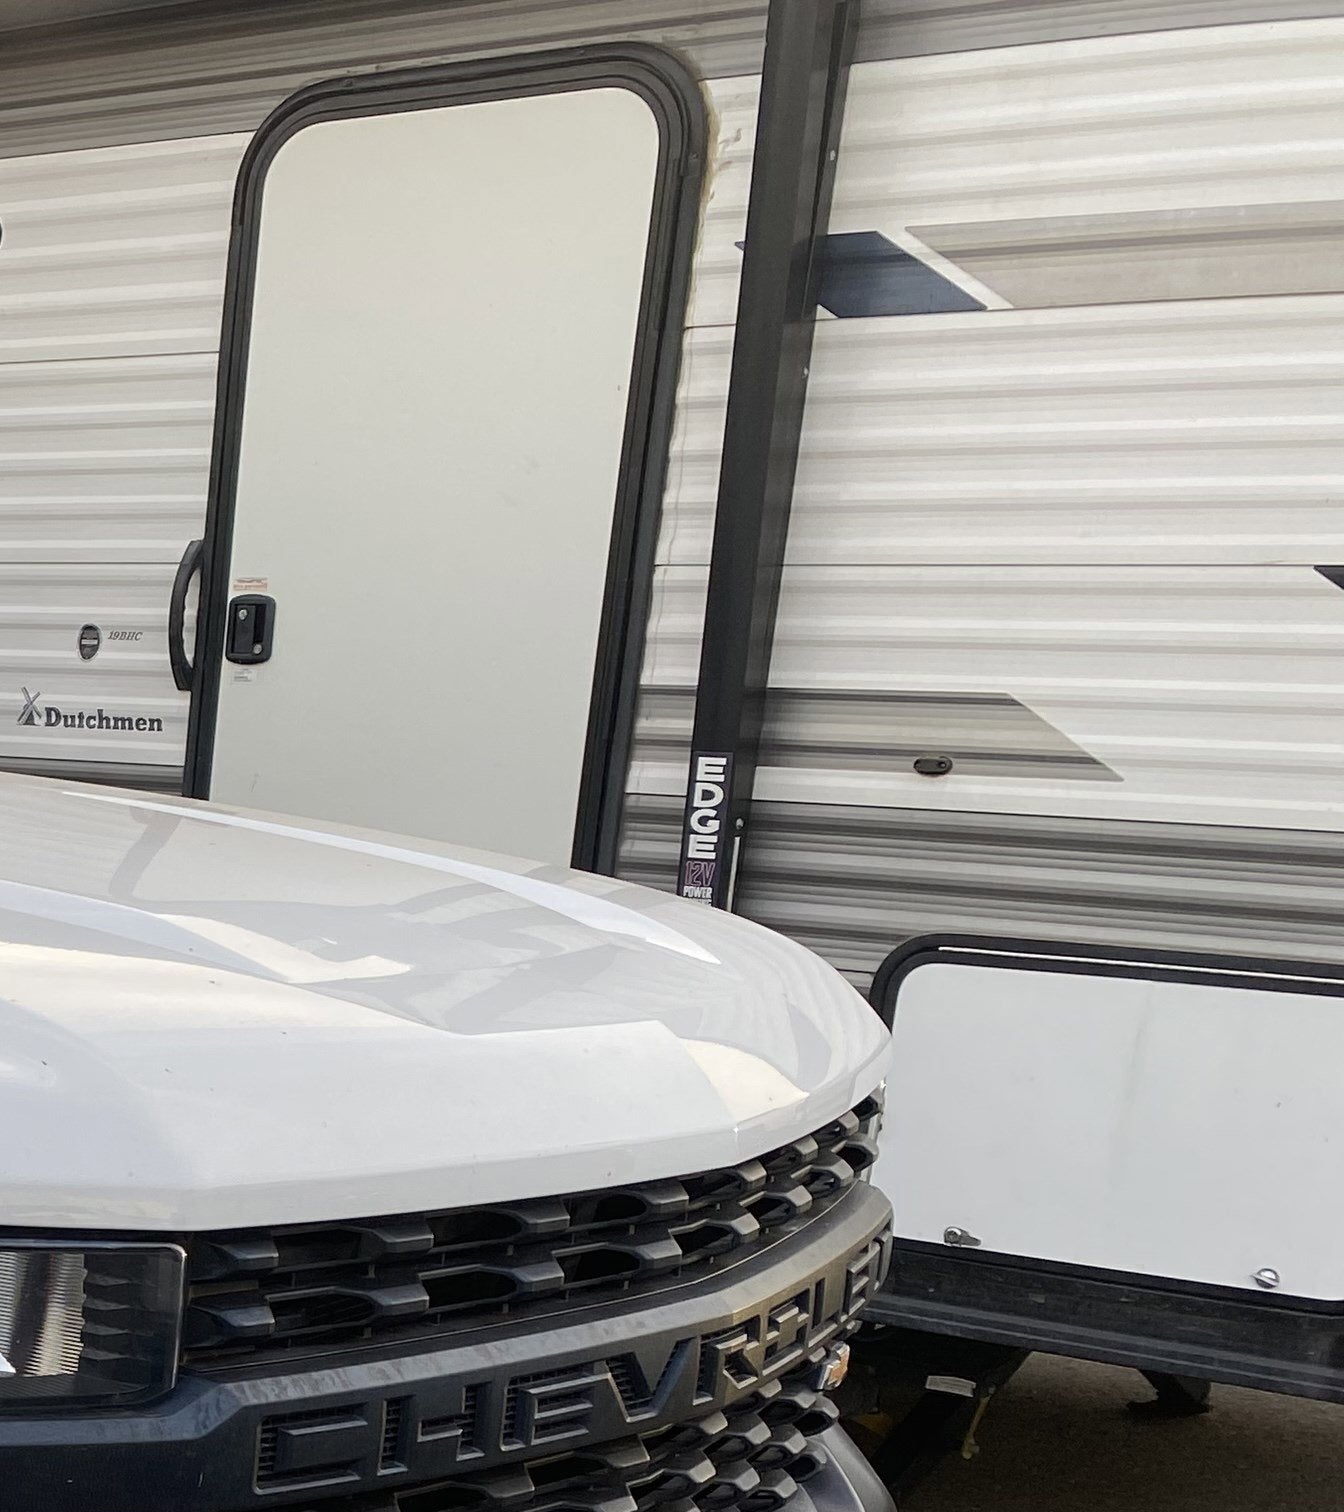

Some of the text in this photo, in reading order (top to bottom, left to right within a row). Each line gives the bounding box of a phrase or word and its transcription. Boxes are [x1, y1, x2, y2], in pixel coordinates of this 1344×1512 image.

[108, 631, 143, 641] 19BHC
[44, 706, 164, 732] Dutchmen
[687, 756, 727, 859] EDGE
[684, 861, 716, 887] 12V
[682, 885, 713, 899] POWER
